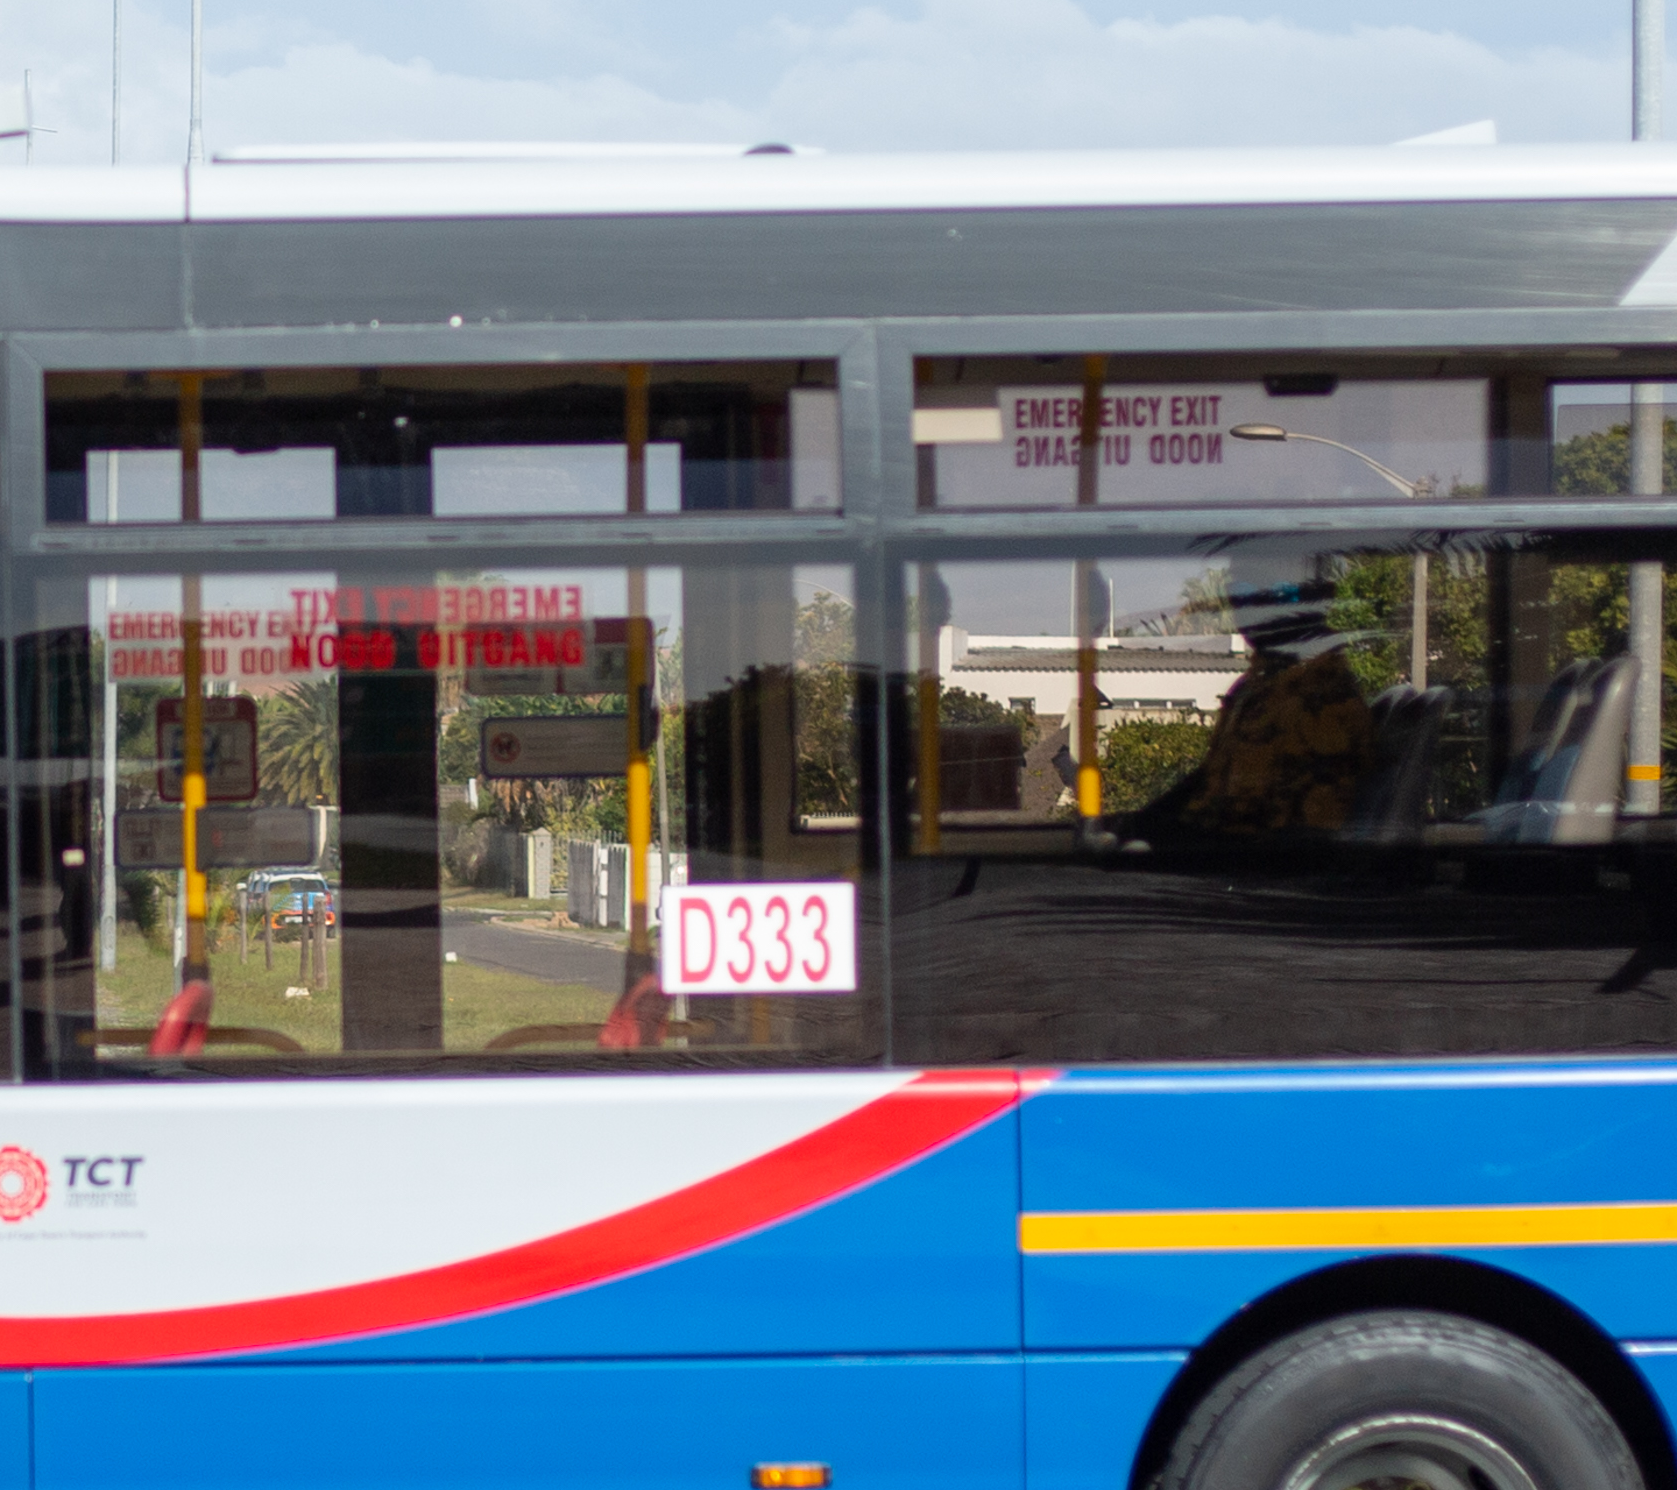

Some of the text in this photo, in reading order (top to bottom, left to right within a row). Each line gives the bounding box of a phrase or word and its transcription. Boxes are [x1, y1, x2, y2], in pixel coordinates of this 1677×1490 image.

[1015, 395, 1222, 428] EMERENCY EXIT
[109, 611, 260, 640] EMERENCY
[416, 628, 585, 670] UITGANG
[680, 895, 831, 984] D333
[63, 1157, 143, 1187] TCT
